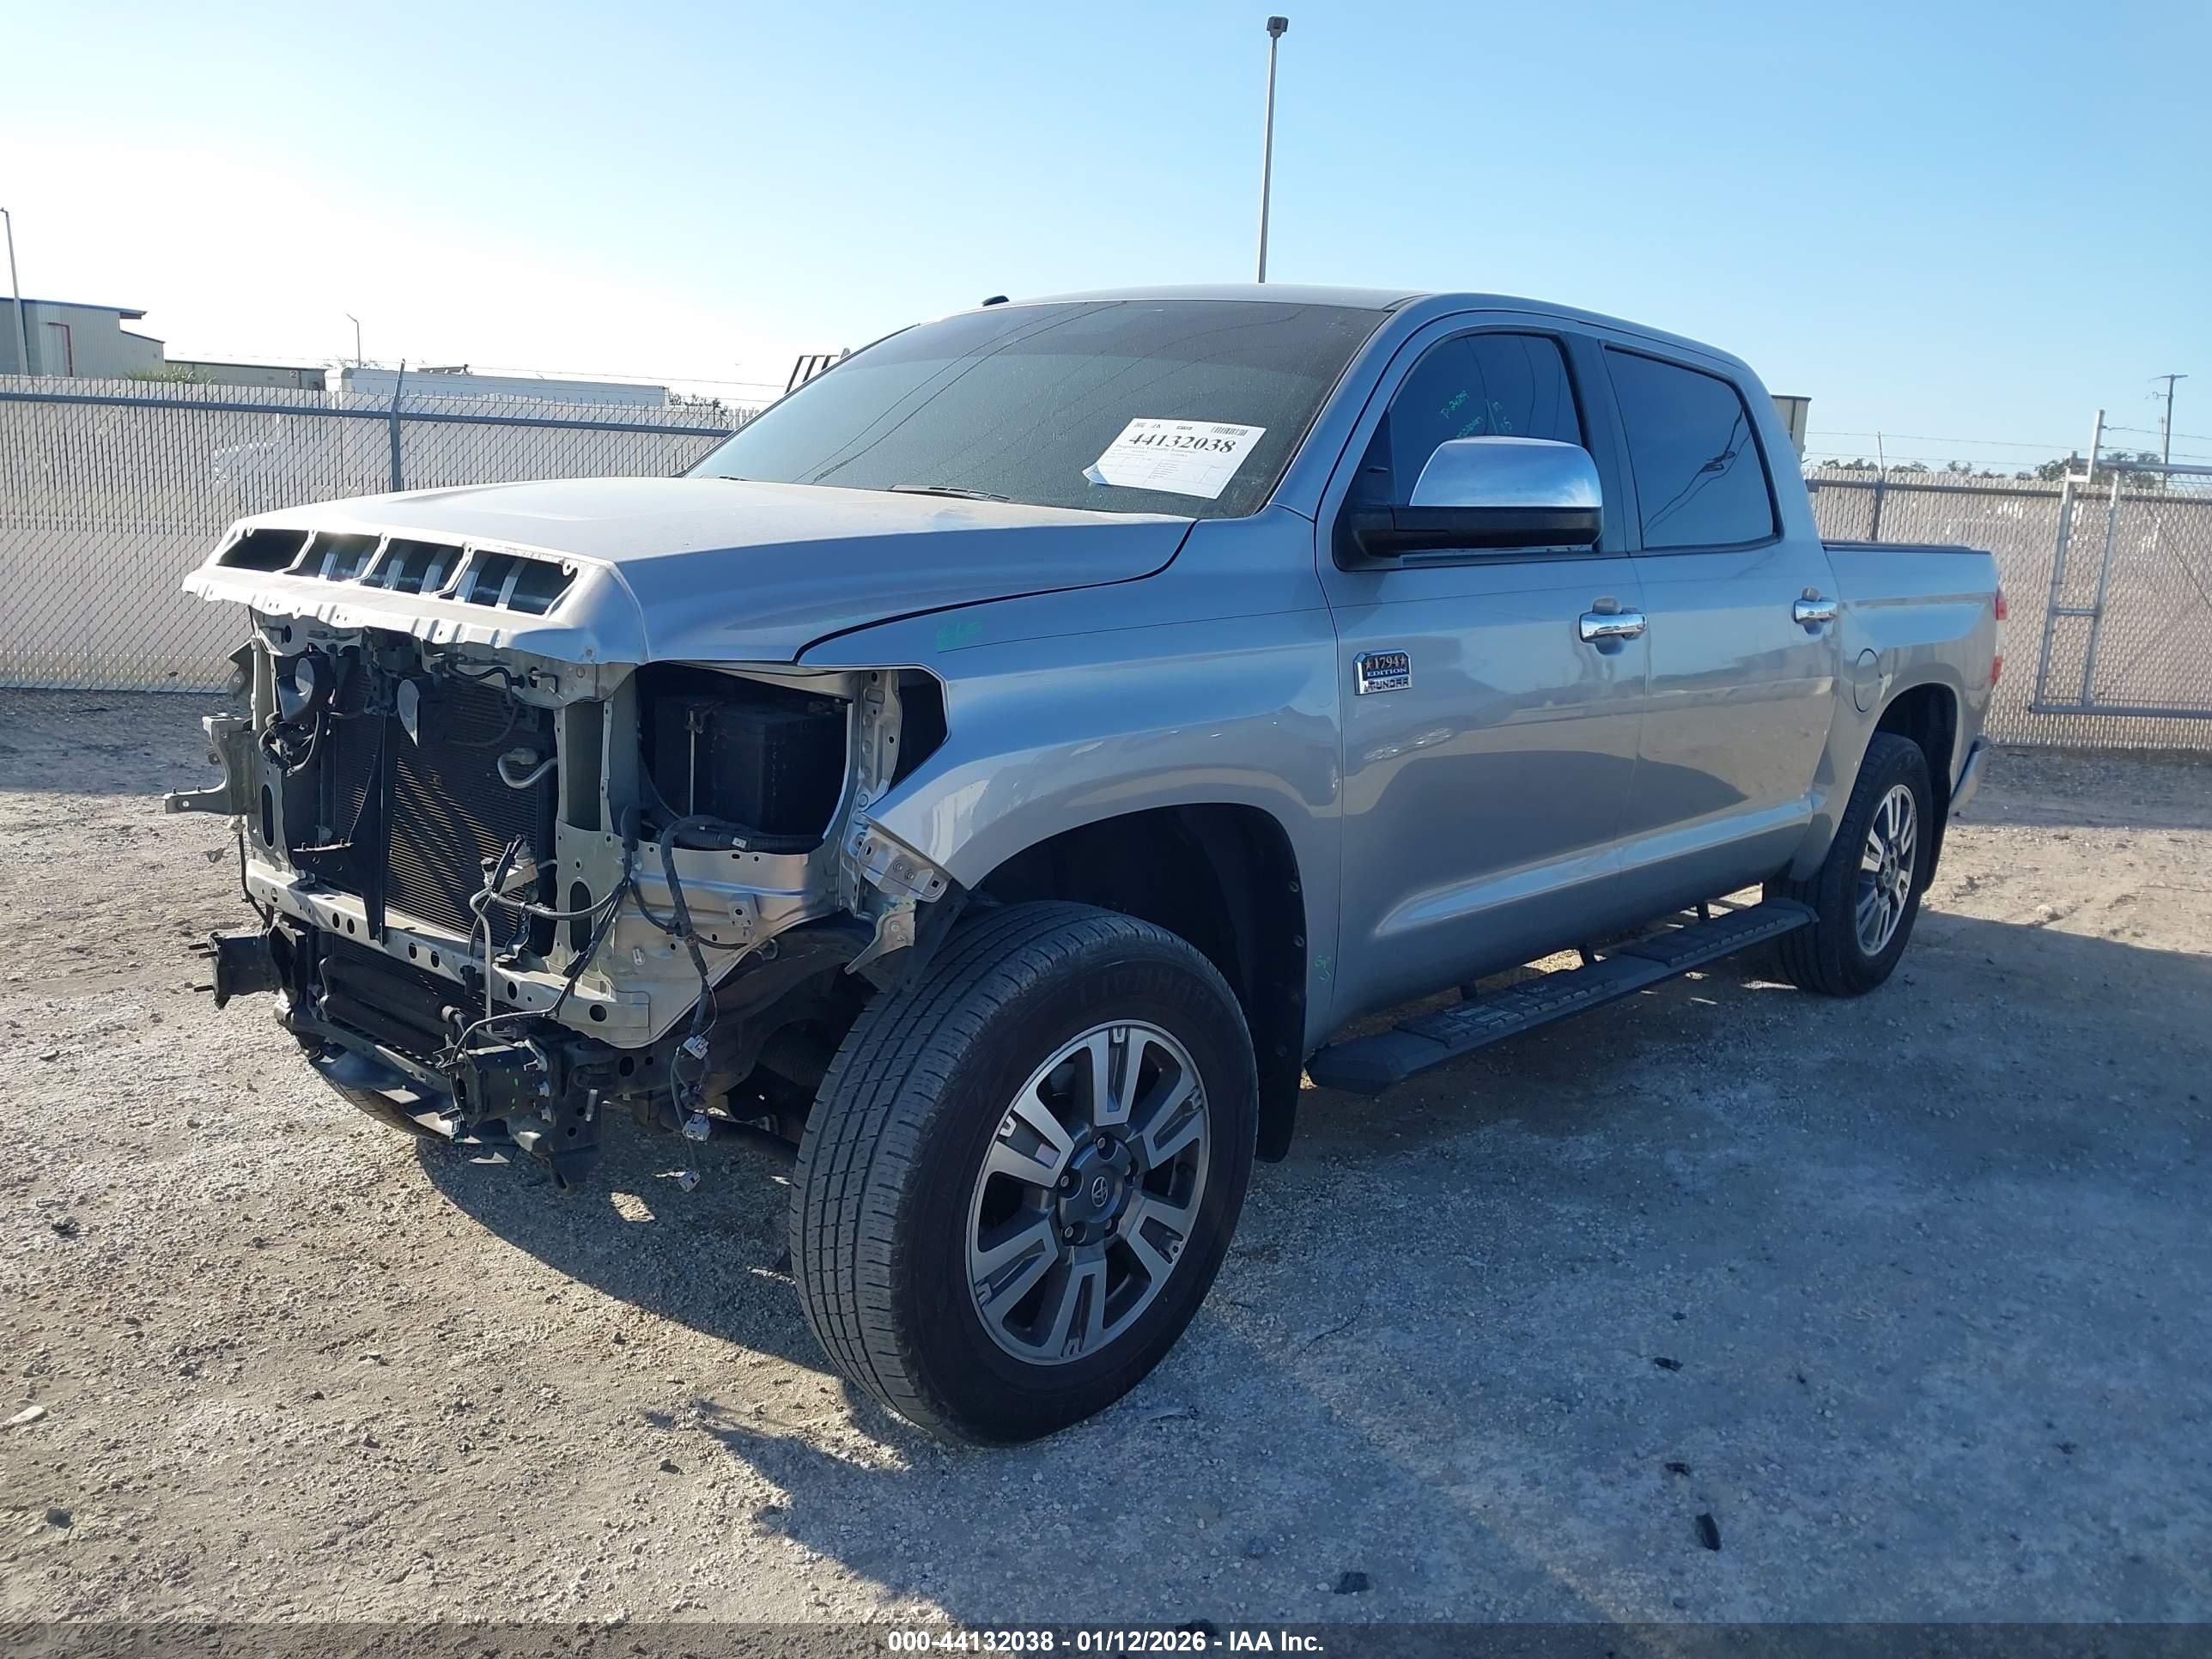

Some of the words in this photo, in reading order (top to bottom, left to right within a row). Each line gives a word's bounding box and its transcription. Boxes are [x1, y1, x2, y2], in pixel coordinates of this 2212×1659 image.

[1128, 433, 1237, 454] 44132038
[1373, 655, 1400, 669] 1794
[1366, 667, 1407, 678] EDITION
